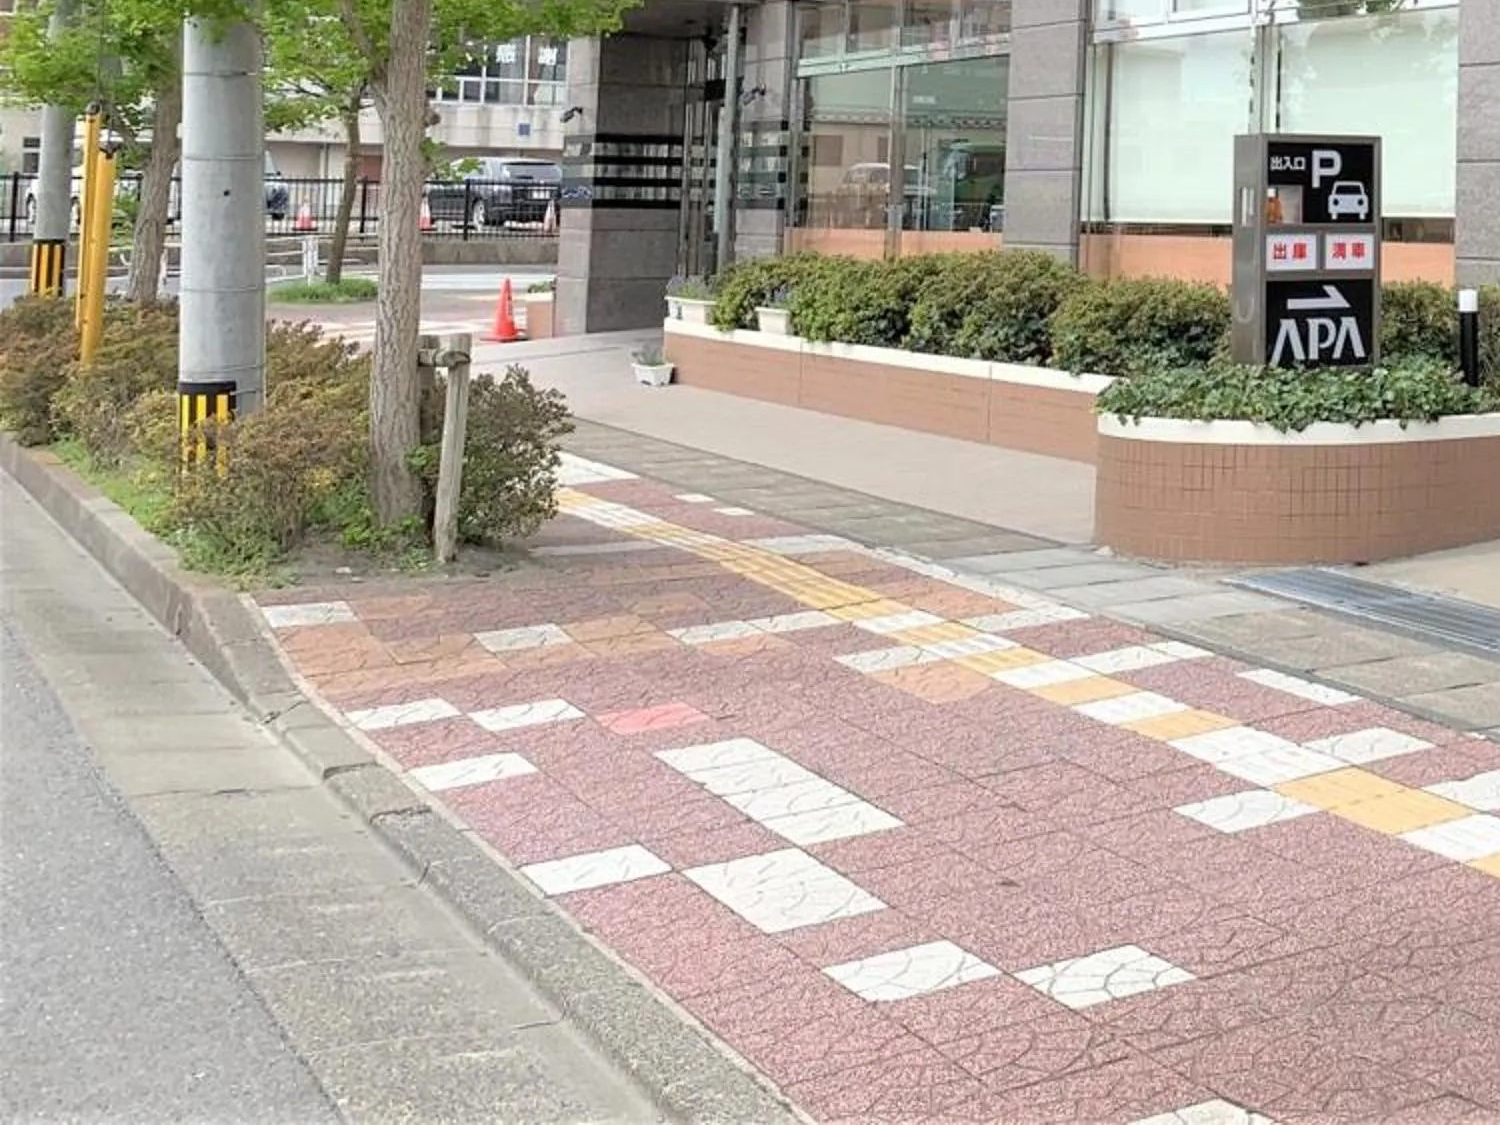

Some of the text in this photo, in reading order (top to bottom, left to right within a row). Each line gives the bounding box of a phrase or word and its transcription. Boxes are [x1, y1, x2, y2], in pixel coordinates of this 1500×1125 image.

[1270, 156, 1306, 171] 出入口
[1311, 149, 1342, 189] P
[1269, 316, 1367, 367] APA
